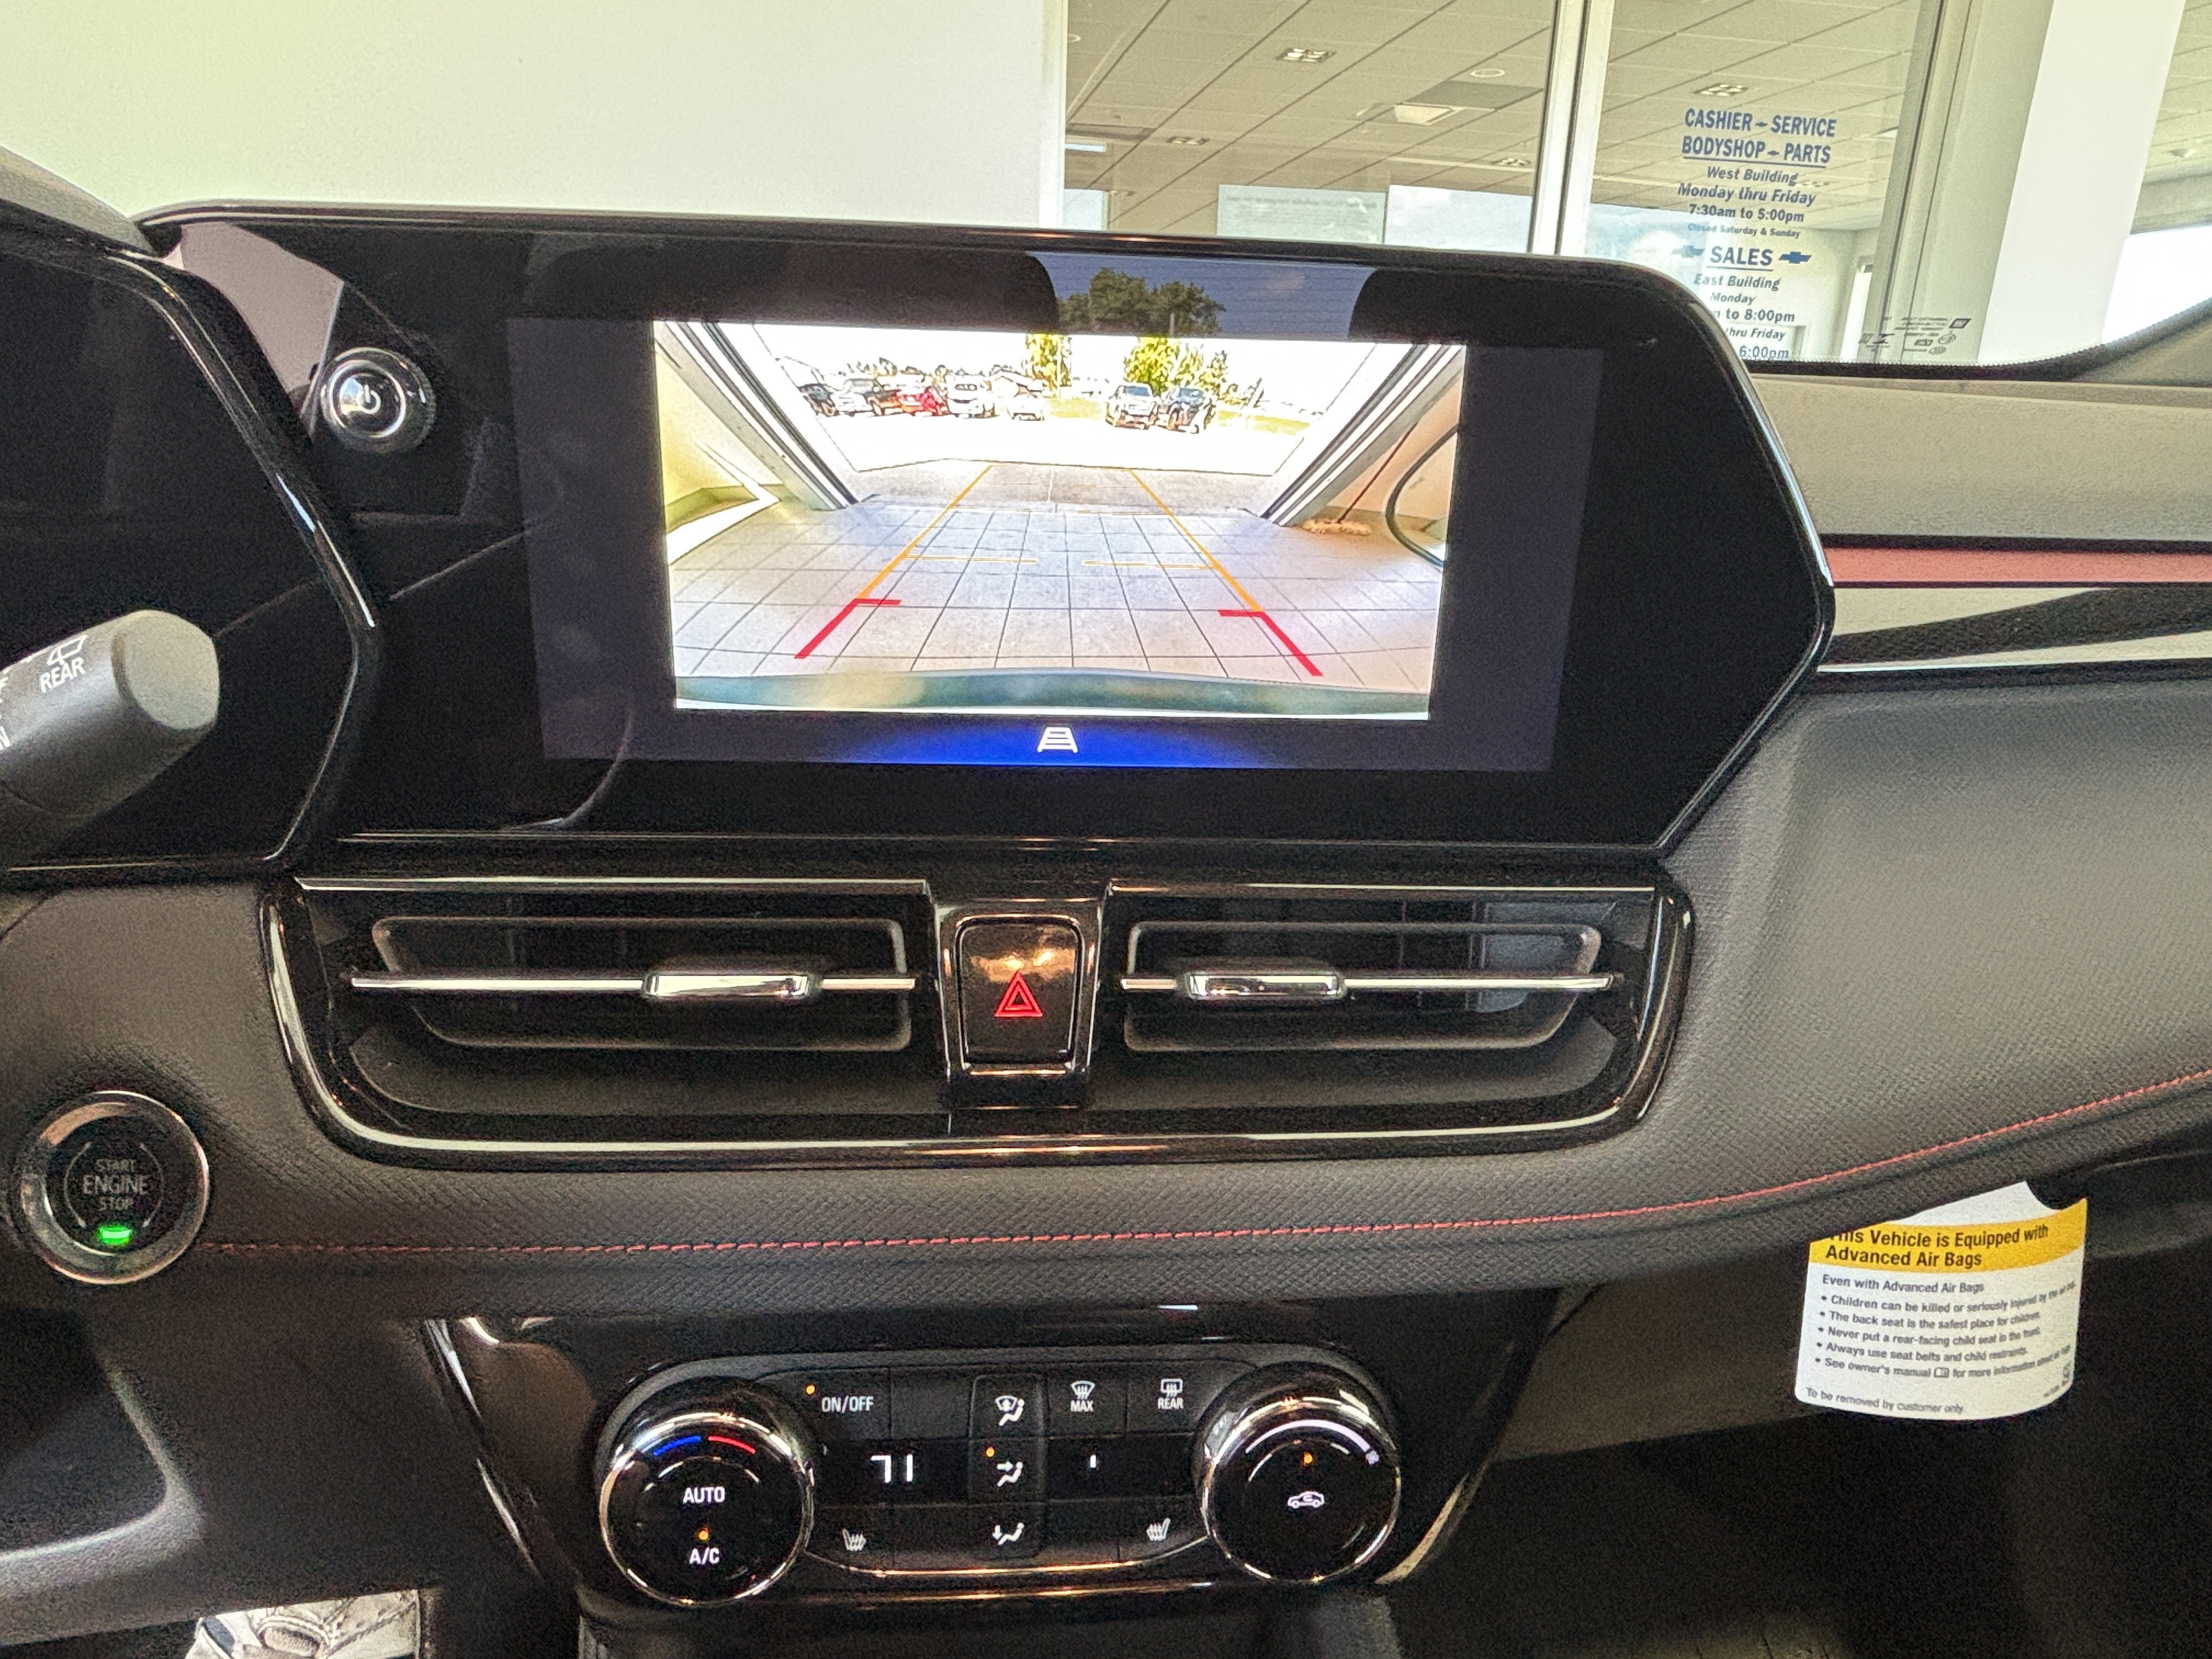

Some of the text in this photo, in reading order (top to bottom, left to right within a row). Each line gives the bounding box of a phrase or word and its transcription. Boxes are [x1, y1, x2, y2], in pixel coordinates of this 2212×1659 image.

[1685, 108, 1837, 137] CASHIER SERVICE
[1681, 136, 1831, 163] BODYSHOP PARTS
[1707, 166, 1799, 187] West Building
[1678, 183, 1816, 207] Monday thru Friday
[1689, 204, 1804, 224] 7:30am to 5:00pm
[1720, 225, 1758, 237] Saturday
[1760, 228, 1767, 236] &
[1770, 228, 1801, 239] Sunday
[1709, 246, 1773, 266] SALES
[1694, 274, 1781, 291] East Building
[1709, 292, 1756, 306] Monday
[1726, 309, 1740, 319] to
[1744, 309, 1796, 324] 8:00pm
[1726, 328, 1786, 341] hru Friday
[41, 657, 85, 693] REAR
[95, 1158, 137, 1172] START
[83, 1174, 150, 1194] ENGINE
[99, 1197, 134, 1211] STOP
[1831, 1224, 2049, 1249] his Vehicle is Equipped with
[1826, 1244, 1982, 1269] Advanced Air Bags
[1822, 1274, 1984, 1294] Even with Advanced Air Bags
[1831, 1295, 1878, 1309] Children
[1881, 1302, 1901, 1311] can
[1905, 1302, 1918, 1312] be
[1922, 1302, 1950, 1313] killed
[1954, 1304, 1965, 1312] or
[1829, 1310, 1850, 1322] The
[1852, 1313, 1878, 1325] back
[1881, 1318, 1904, 1328] seat
[1908, 1318, 1916, 1328] is
[1919, 1319, 1936, 1329] the
[1938, 1319, 1968, 1329] safest
[1828, 1326, 1860, 1339] Never
[1863, 1332, 1881, 1343] put
[1893, 1335, 1950, 1348] rear-facing
[1953, 1335, 1976, 1345] child
[1826, 1342, 1865, 1357] Always
[1868, 1349, 1887, 1358] use
[1890, 1351, 1914, 1360] seat
[1916, 1351, 1941, 1362] belts
[1944, 1352, 1962, 1362] and
[1965, 1351, 1987, 1361] child
[1825, 1357, 1846, 1369] See
[1848, 1362, 1890, 1375] owner's
[1893, 1368, 1931, 1378] manual
[822, 1397, 874, 1412] ON/OFF
[1070, 1398, 1094, 1413] MAX
[1158, 1398, 1183, 1410] REAR
[1807, 1387, 1963, 1415] To be removed by customer only
[683, 1487, 726, 1503] AUTO
[689, 1548, 720, 1564] A/C
